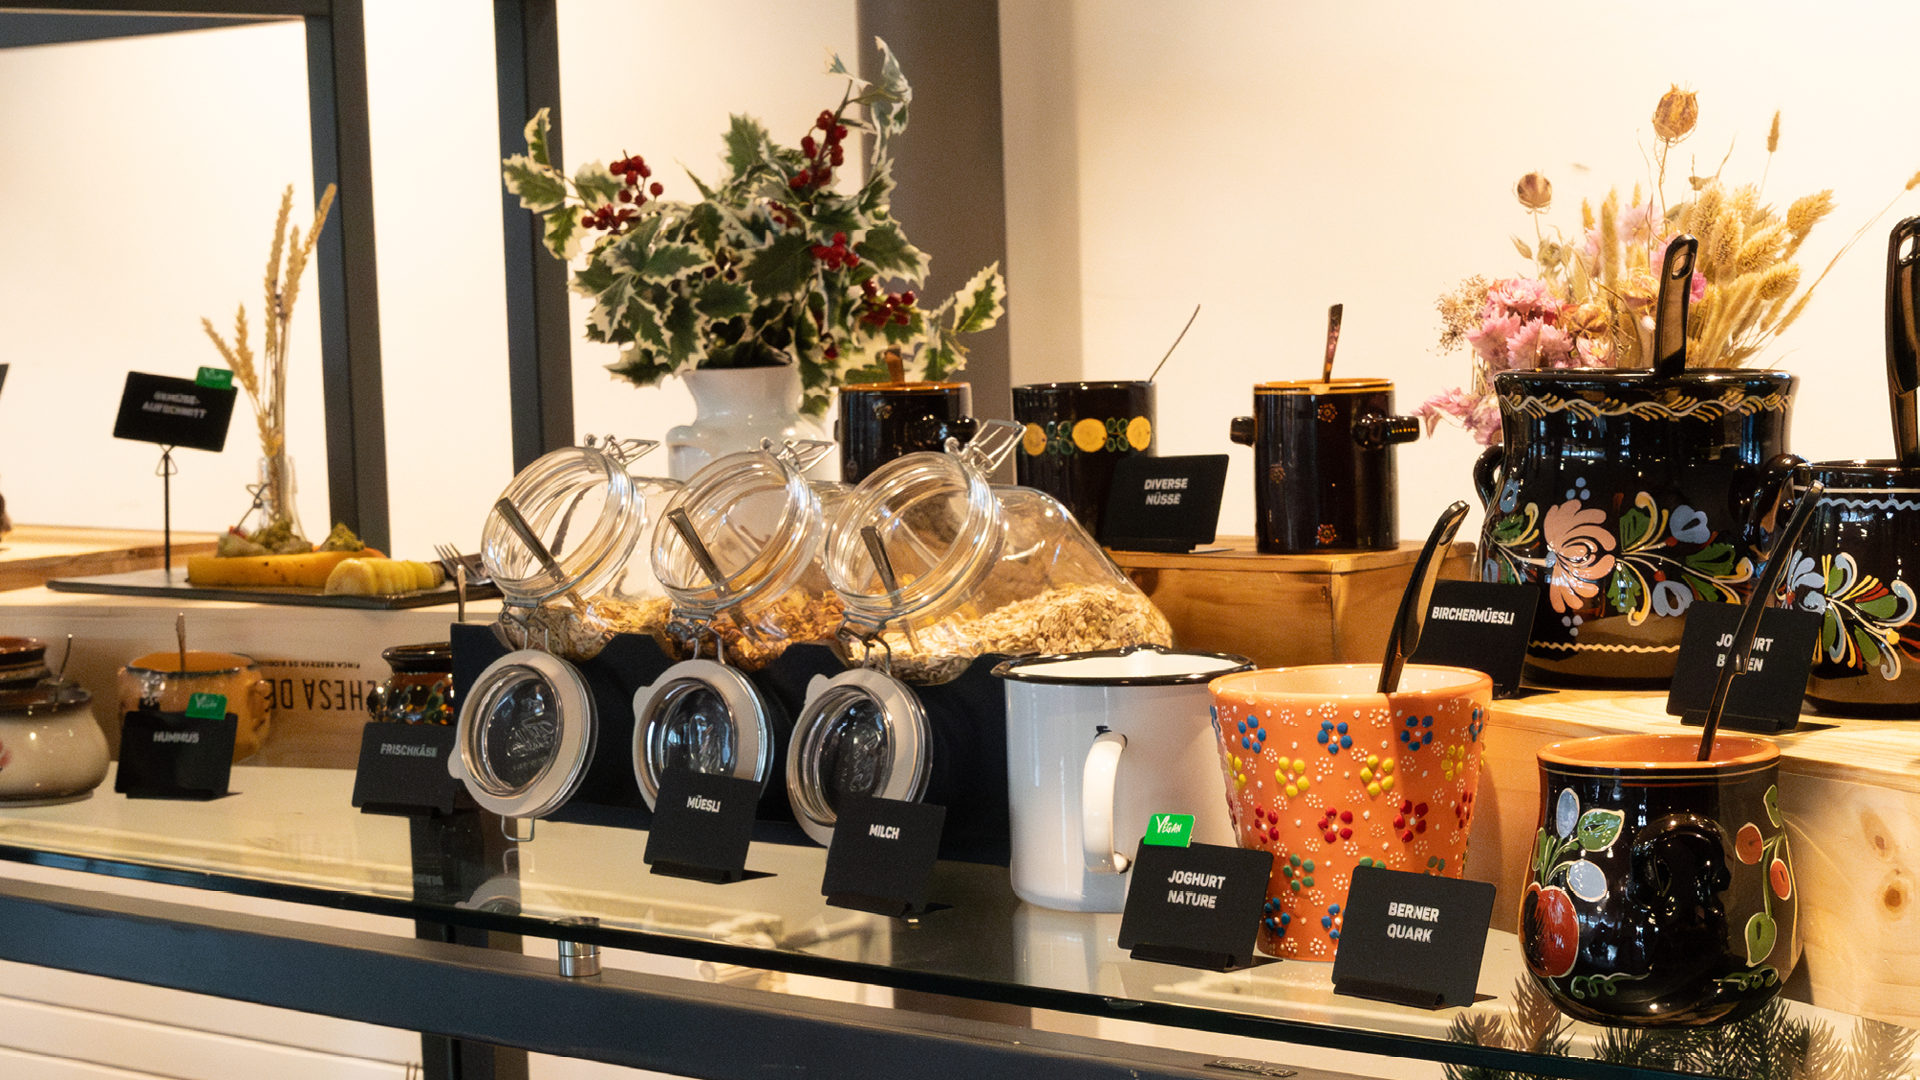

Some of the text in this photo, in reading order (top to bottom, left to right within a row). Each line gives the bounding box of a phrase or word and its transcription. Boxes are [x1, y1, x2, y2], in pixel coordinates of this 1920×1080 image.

[1144, 477, 1189, 490] DIVERSE
[1145, 491, 1182, 505] NÜSSE
[1431, 606, 1515, 626] BIRCHERMÜESLI
[153, 731, 200, 743] HUMMUS
[380, 743, 438, 758] FRISCHKÄSE
[686, 795, 721, 813] MÜESLI
[868, 823, 900, 840] MILCH
[1156, 815, 1182, 834] VEGAN
[1167, 870, 1226, 890] JOGHURT
[1167, 889, 1218, 909] NATURE
[1388, 901, 1440, 923] BERNER
[1386, 923, 1434, 943] QUARK
